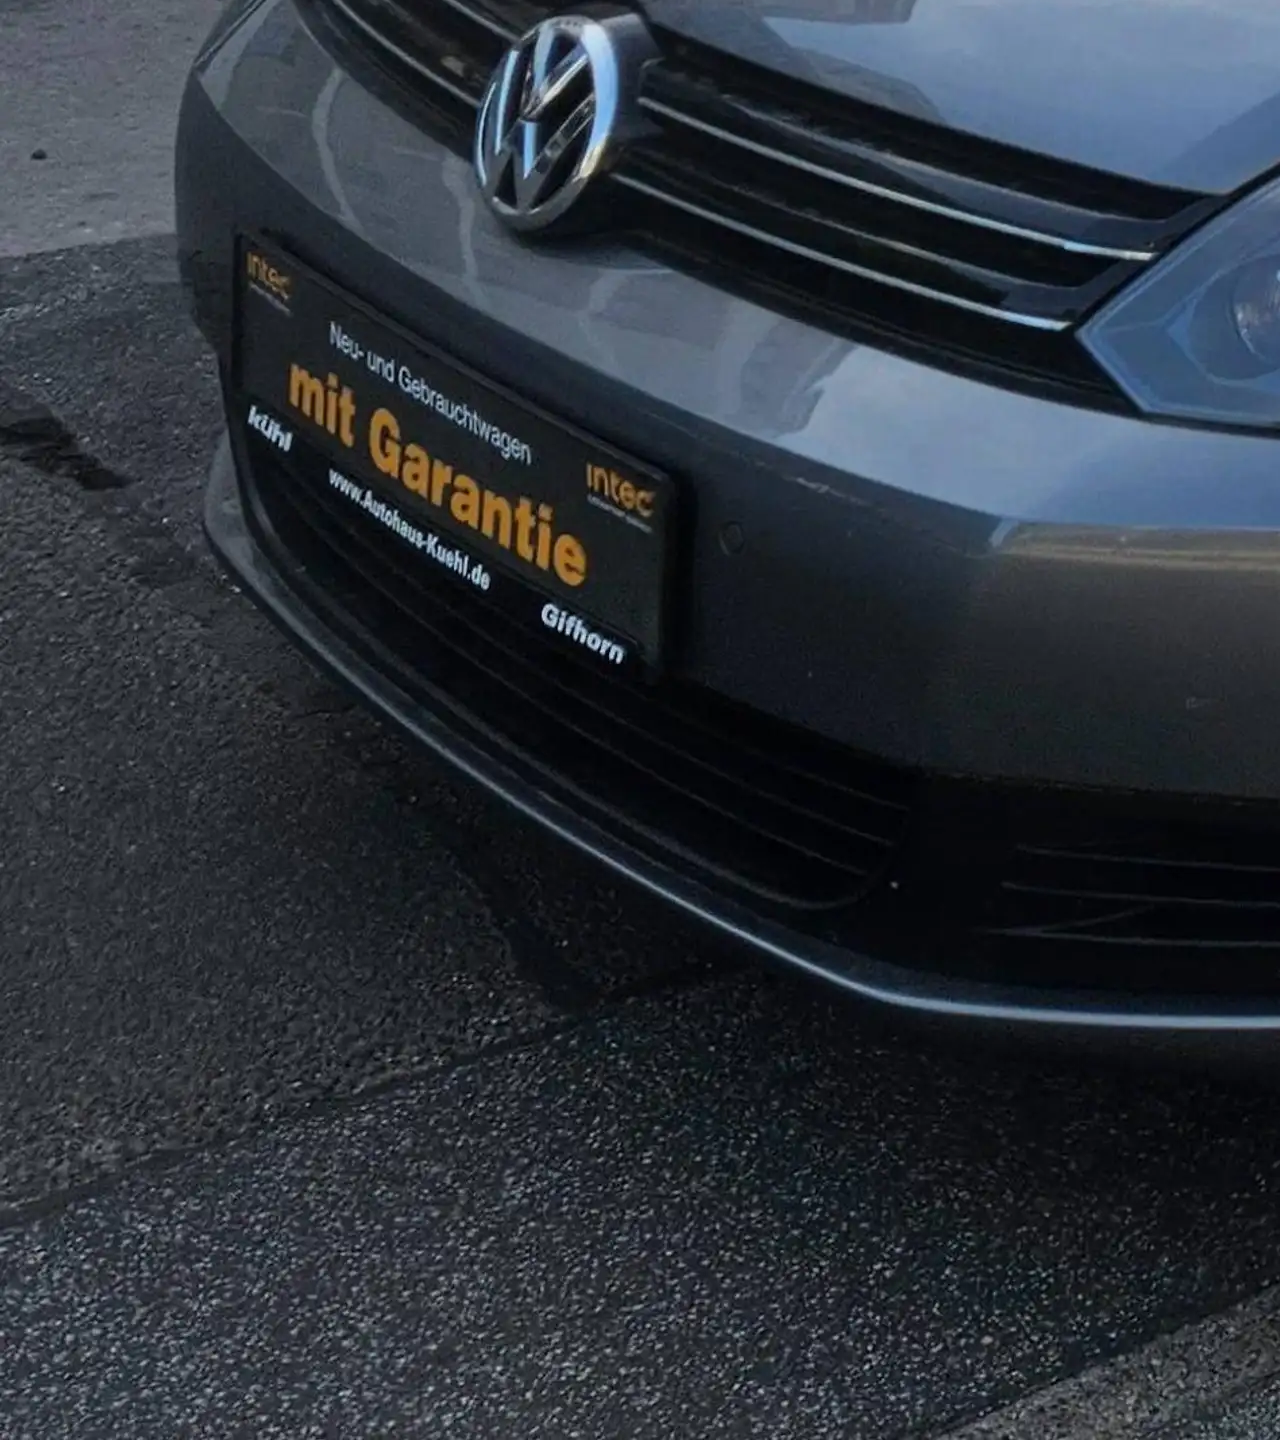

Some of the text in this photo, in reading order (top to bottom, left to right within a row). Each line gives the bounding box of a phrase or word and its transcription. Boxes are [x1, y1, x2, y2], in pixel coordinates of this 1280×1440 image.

[329, 321, 532, 465] Neu- und Gebrauchtwagen
[288, 363, 588, 587] mit Garantie
[328, 468, 491, 591] www.Autohaus-Kuehl.de
[540, 602, 626, 664] Gifhorn
